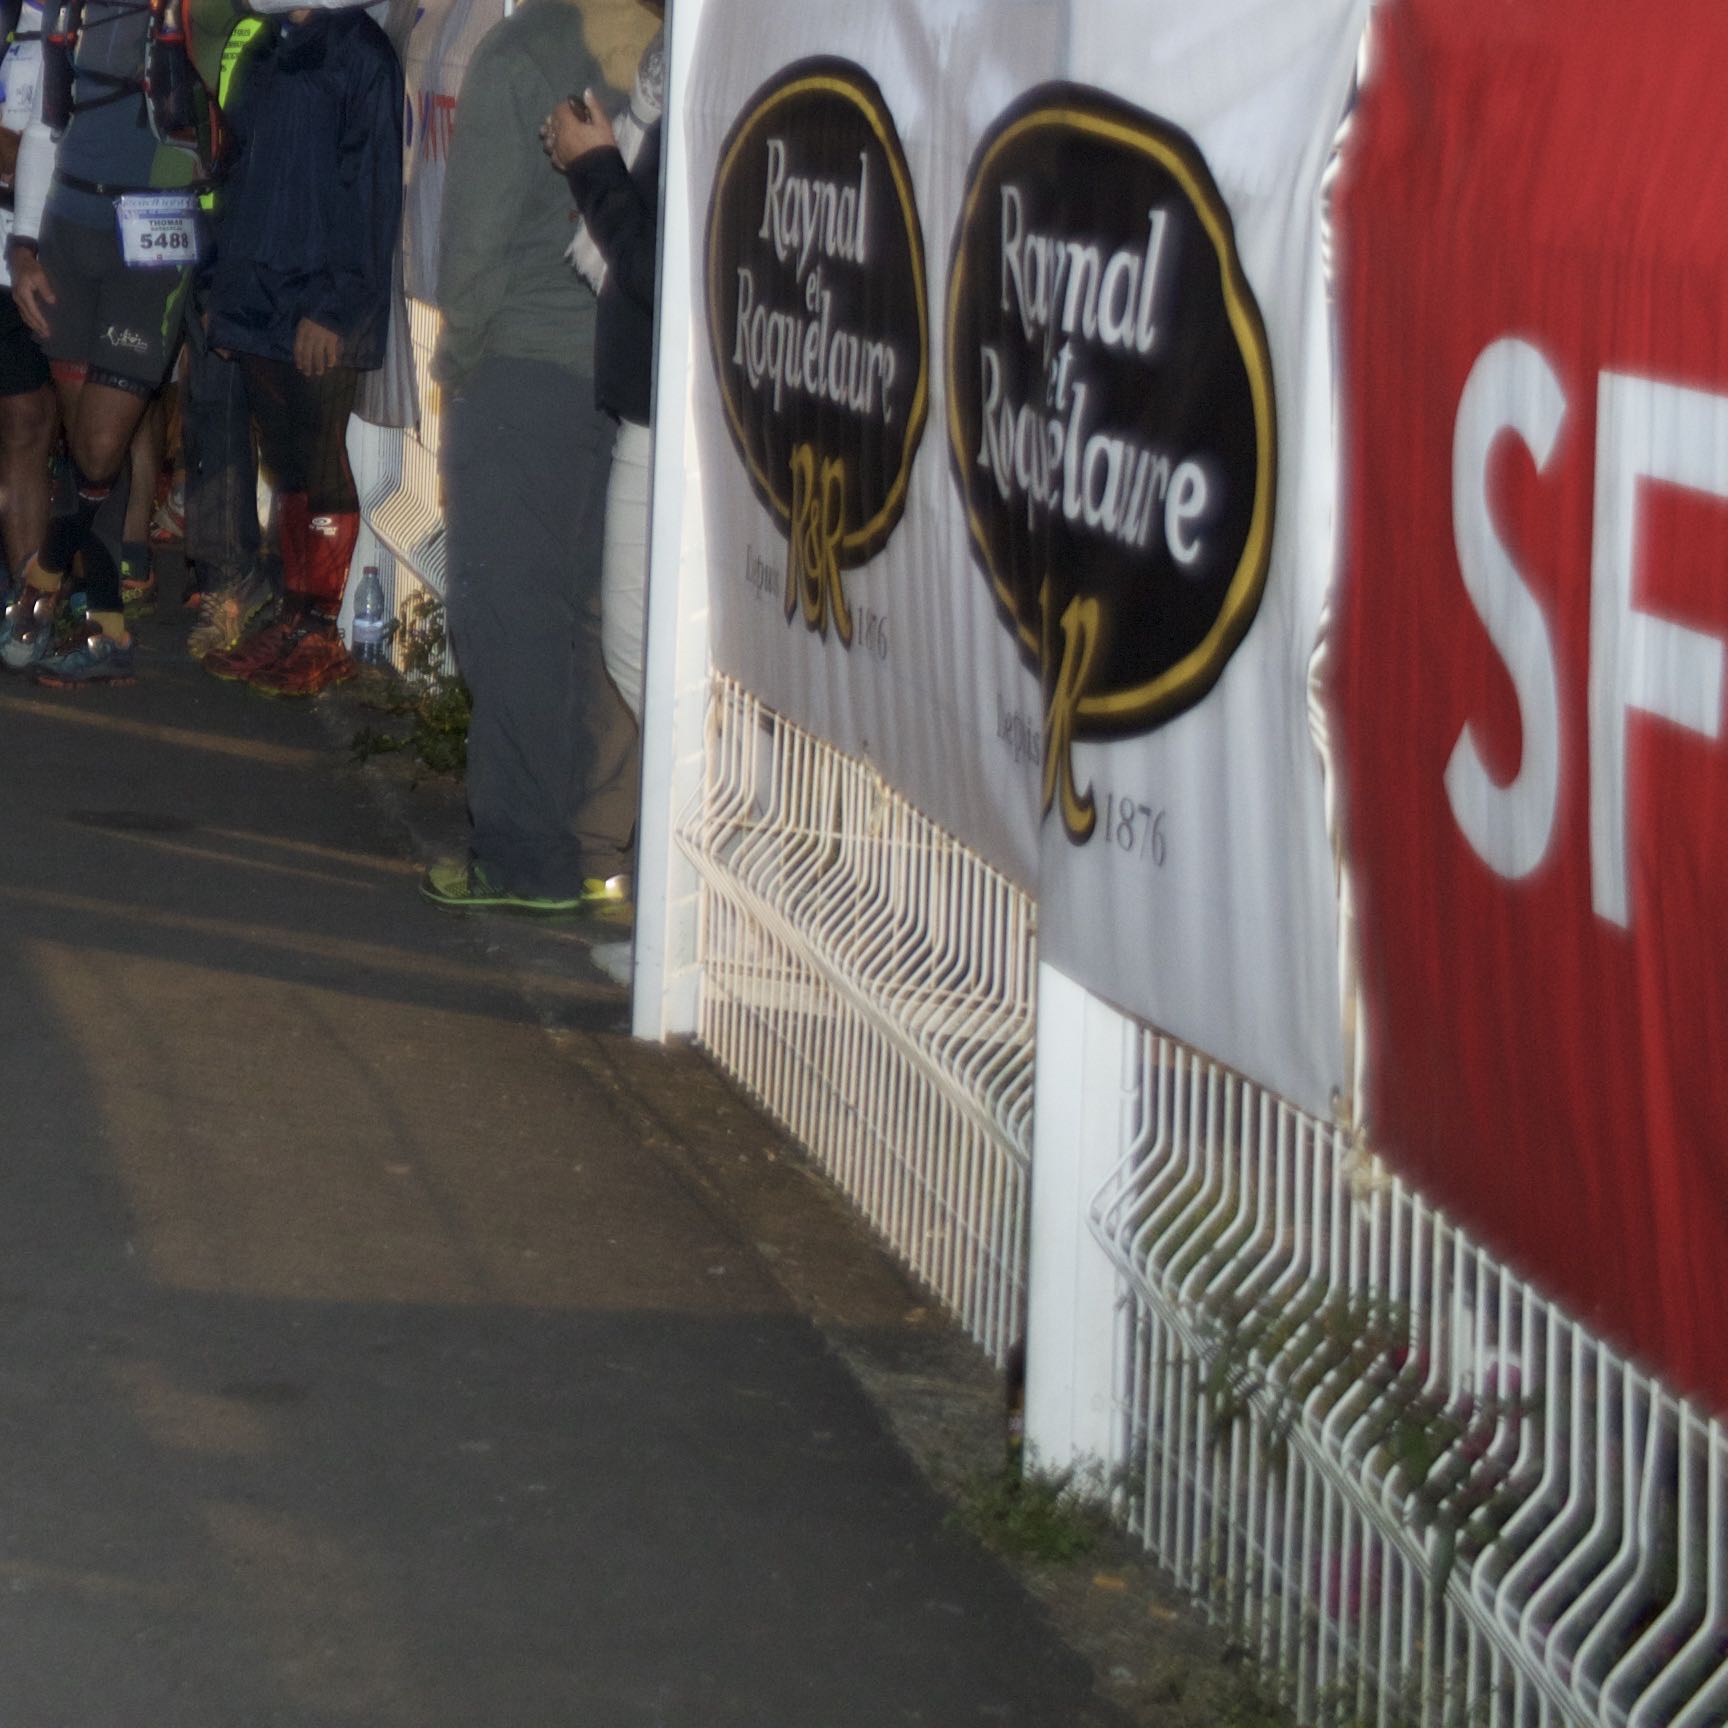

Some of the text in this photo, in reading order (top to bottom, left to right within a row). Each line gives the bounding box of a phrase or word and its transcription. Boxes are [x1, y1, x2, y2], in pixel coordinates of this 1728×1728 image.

[140, 232, 189, 249] 5488
[758, 138, 870, 286] Raynal
[999, 183, 1172, 380] Raynal
[732, 266, 897, 426] Roquelaure
[1103, 790, 1169, 870] 1876
